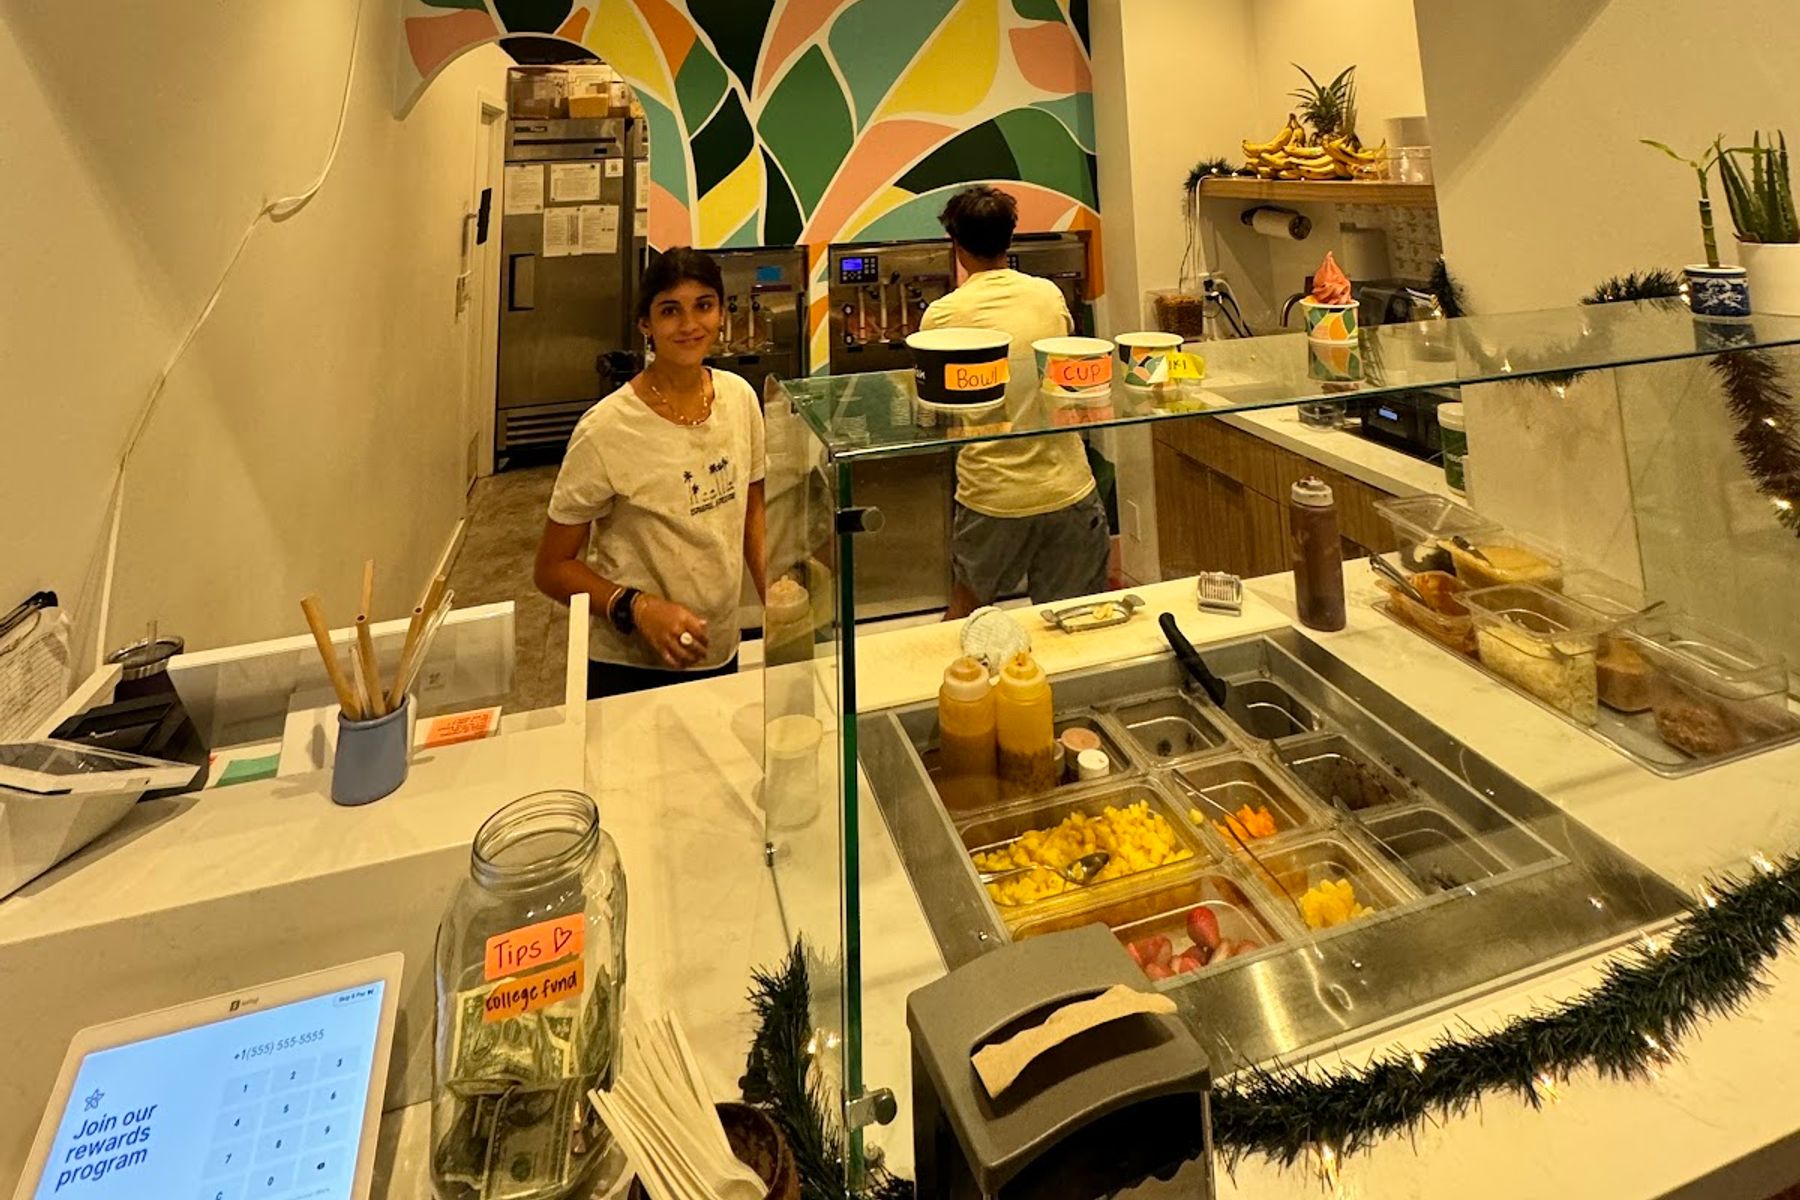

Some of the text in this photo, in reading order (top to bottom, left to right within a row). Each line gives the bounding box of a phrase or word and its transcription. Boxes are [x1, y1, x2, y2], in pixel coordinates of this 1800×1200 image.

[956, 366, 998, 388] Bowl
[1063, 365, 1101, 382] CUP
[493, 940, 542, 969] Tips
[485, 970, 577, 1011] college fund
[73, 1103, 159, 1140] Join our
[64, 1125, 152, 1165] rewards
[55, 1148, 148, 1192] program
